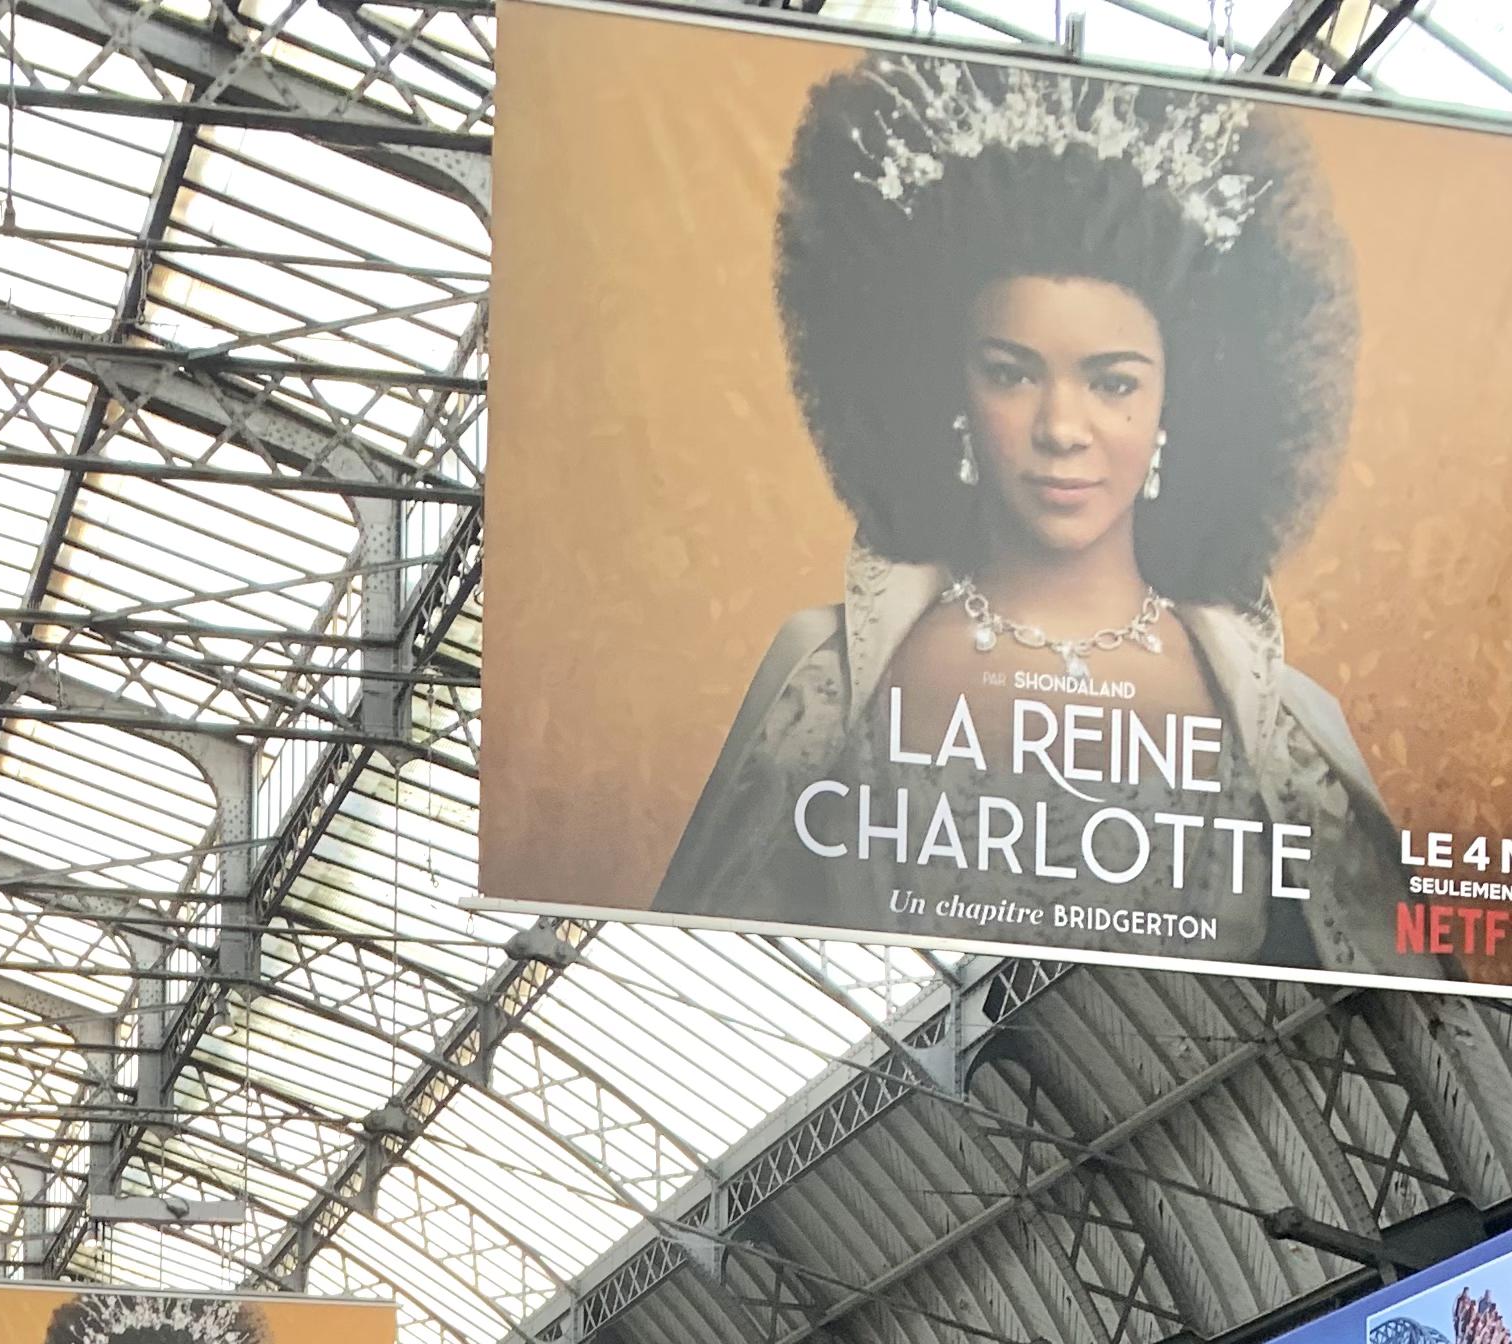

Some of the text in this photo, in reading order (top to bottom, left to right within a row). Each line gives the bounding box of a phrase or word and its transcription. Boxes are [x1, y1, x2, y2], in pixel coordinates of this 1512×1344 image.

[1014, 670, 1135, 699] SHONDALAND
[889, 687, 1222, 801] LA REINE
[794, 780, 1311, 899] CHARLOTTE
[1401, 830, 1452, 868] LE
[1463, 836, 1490, 871] 4
[889, 888, 1217, 940] Un chapitre BRIDGERTON
[1410, 876, 1512, 900] SEULEMEN
[1397, 902, 1509, 956] NETF
